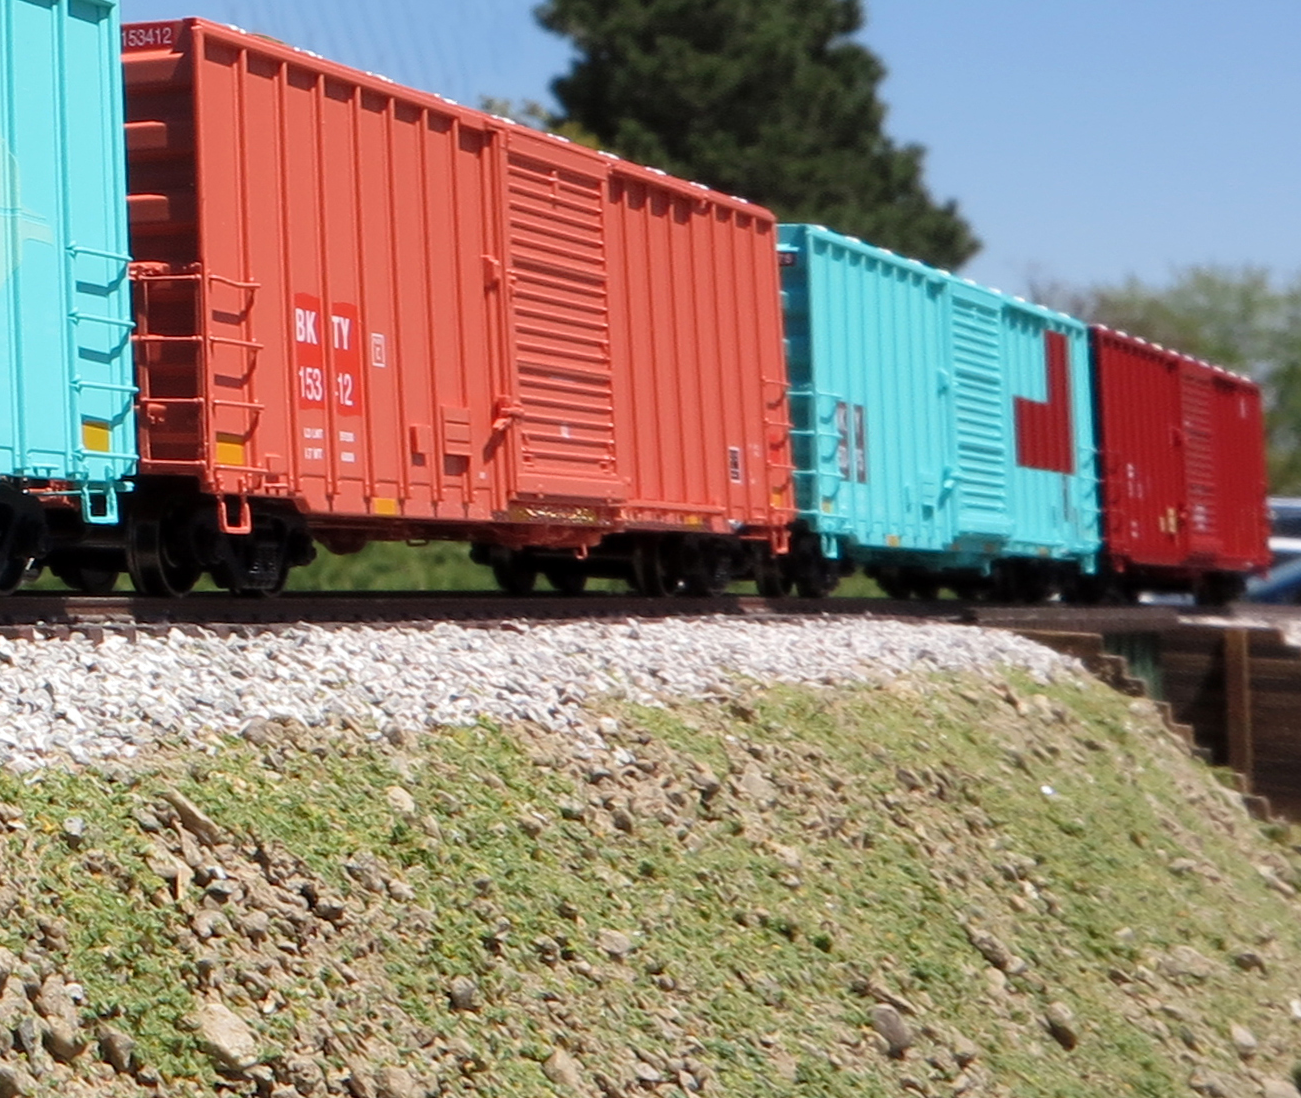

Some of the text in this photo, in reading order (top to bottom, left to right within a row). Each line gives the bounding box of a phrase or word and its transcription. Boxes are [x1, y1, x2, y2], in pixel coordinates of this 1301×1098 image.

[121, 27, 173, 47] 153412
[295, 307, 351, 350] BK TY
[298, 365, 354, 406] 153 12
